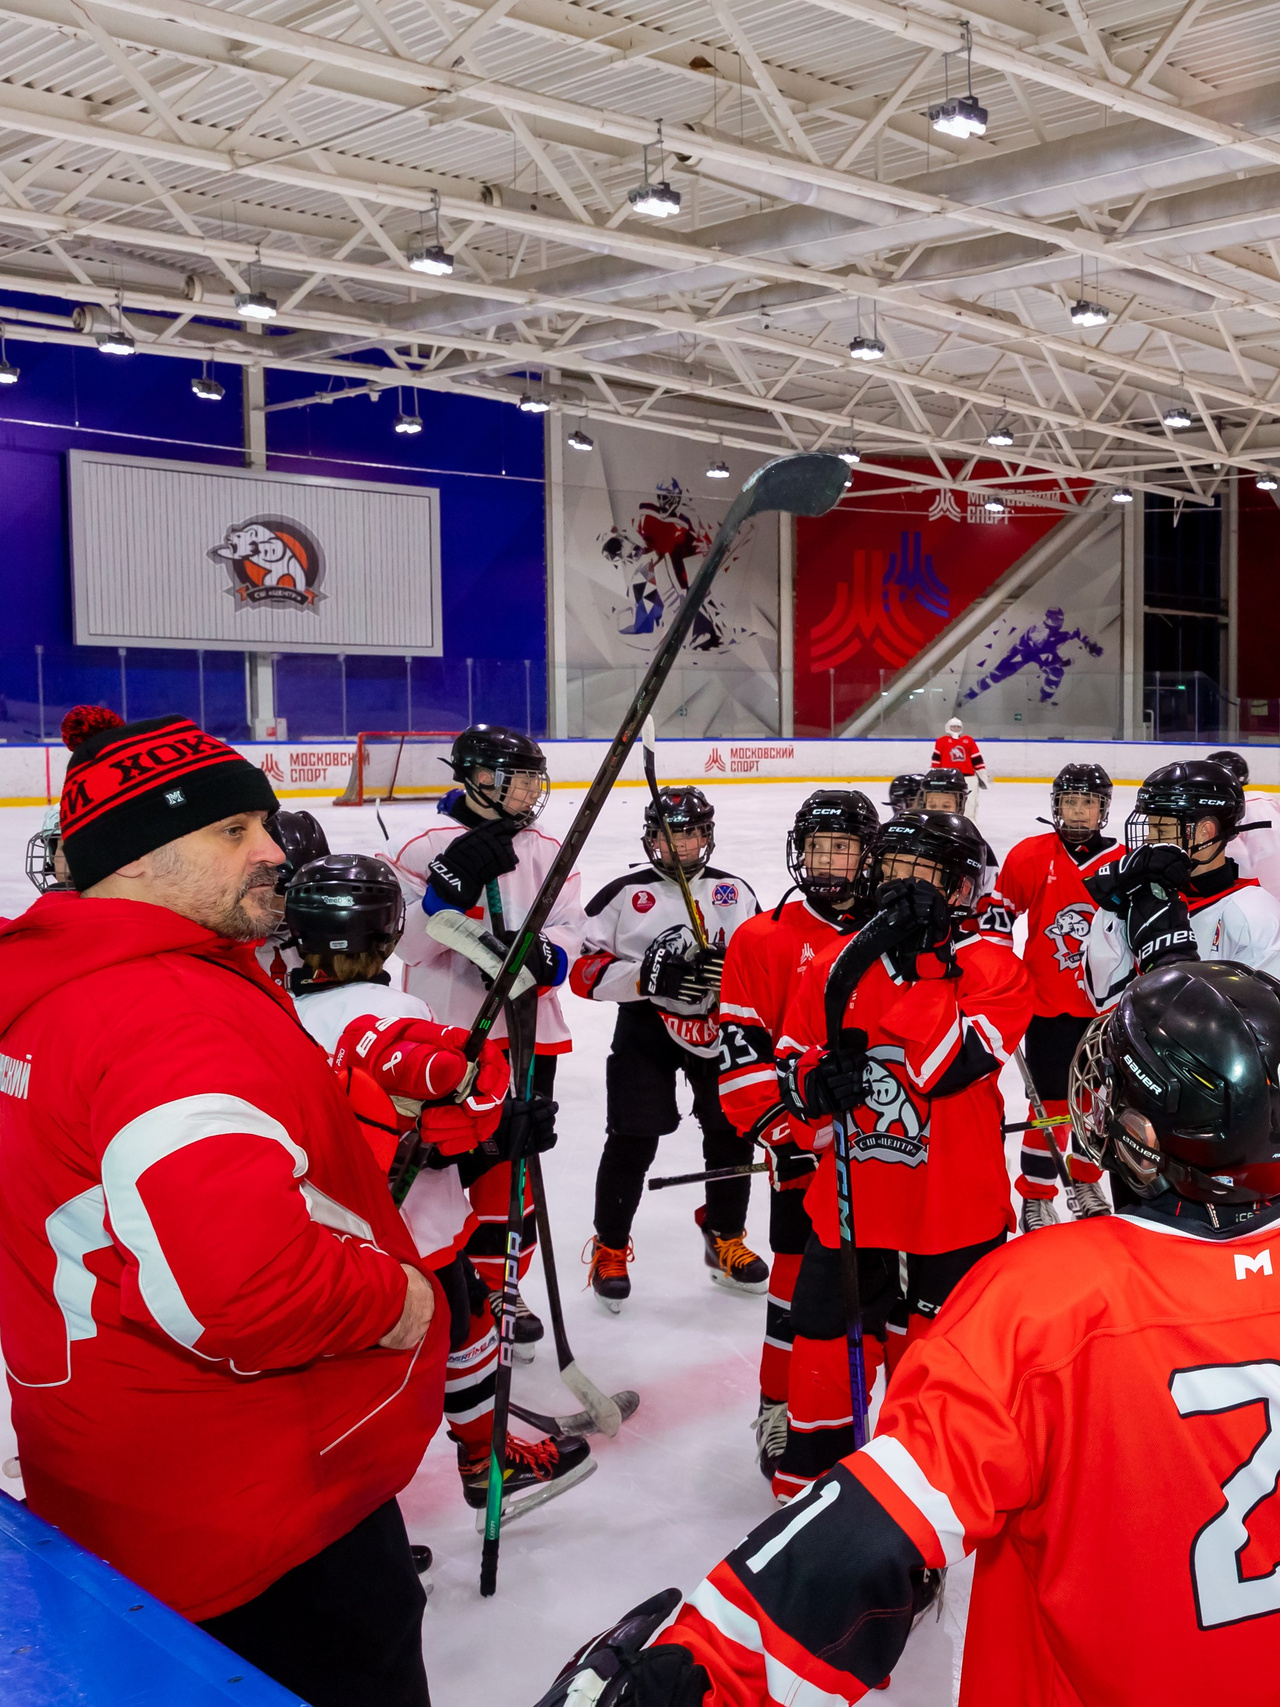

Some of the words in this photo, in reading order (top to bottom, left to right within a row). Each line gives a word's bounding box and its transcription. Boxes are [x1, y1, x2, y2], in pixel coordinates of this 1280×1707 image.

[730, 744, 794, 759] МОСКОВСКИЙ
[730, 760, 760, 772] СПОРТ
[290, 767, 328, 783] СПОРТ
[888, 826, 916, 834] CCM
[966, 858, 982, 868] CCM
[336, 1047, 346, 1066] PRO
[1123, 1054, 1163, 1096] BAUER
[860, 1137, 876, 1149] СШ
[877, 1137, 917, 1154] «ЦЕНТР»
[1122, 1134, 1161, 1163] BAUER
[1234, 1249, 1273, 1281] M
